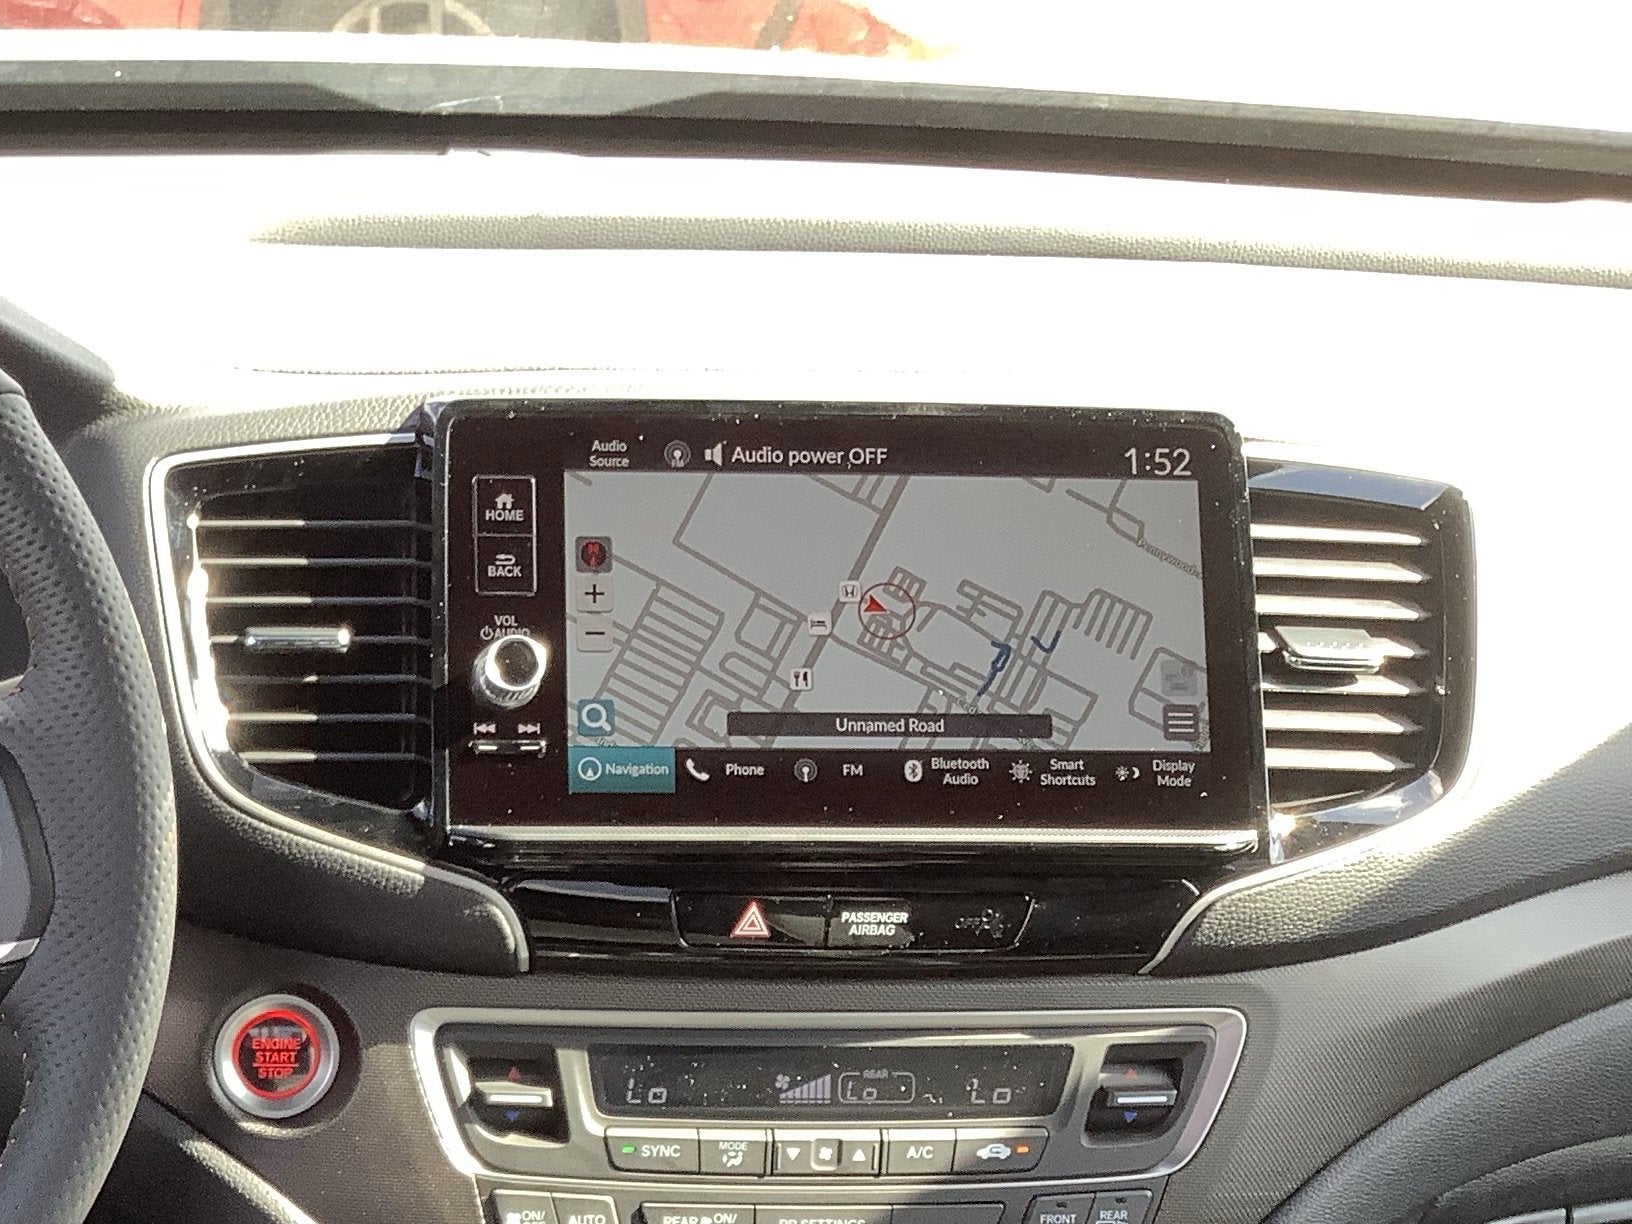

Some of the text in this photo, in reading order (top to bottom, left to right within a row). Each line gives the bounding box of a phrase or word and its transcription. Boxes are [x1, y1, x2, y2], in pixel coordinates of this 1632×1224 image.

[591, 440, 627, 454] Audio
[589, 455, 630, 468] Source
[731, 446, 888, 469] Audio power OFF
[1124, 447, 1192, 477] 1:52
[485, 508, 525, 522] HOME
[487, 565, 522, 578] BACK
[494, 614, 518, 627] VOL
[494, 627, 531, 640] AUDIO
[835, 717, 945, 733] Unnamed Road
[605, 762, 670, 778] Navigation
[725, 762, 765, 777] Phone
[842, 764, 864, 777] FM
[931, 757, 990, 771] Bluetooth
[1050, 758, 1085, 771] Smart
[1152, 759, 1196, 775] Display
[942, 772, 979, 786] Audio
[1040, 772, 1097, 787] Shortcuts
[1157, 774, 1192, 788] Mode
[841, 911, 909, 925] PASSENGER
[848, 923, 896, 936] AIRBAG
[252, 1037, 302, 1050] ENGINE
[255, 1051, 298, 1064] START
[258, 1067, 294, 1079] STOP
[641, 1144, 681, 1159] SYNC
[719, 1140, 749, 1152] MODE
[906, 1145, 934, 1160] A/C
[1040, 1213, 1077, 1224] FRONT
[1099, 1209, 1128, 1222] REAR
